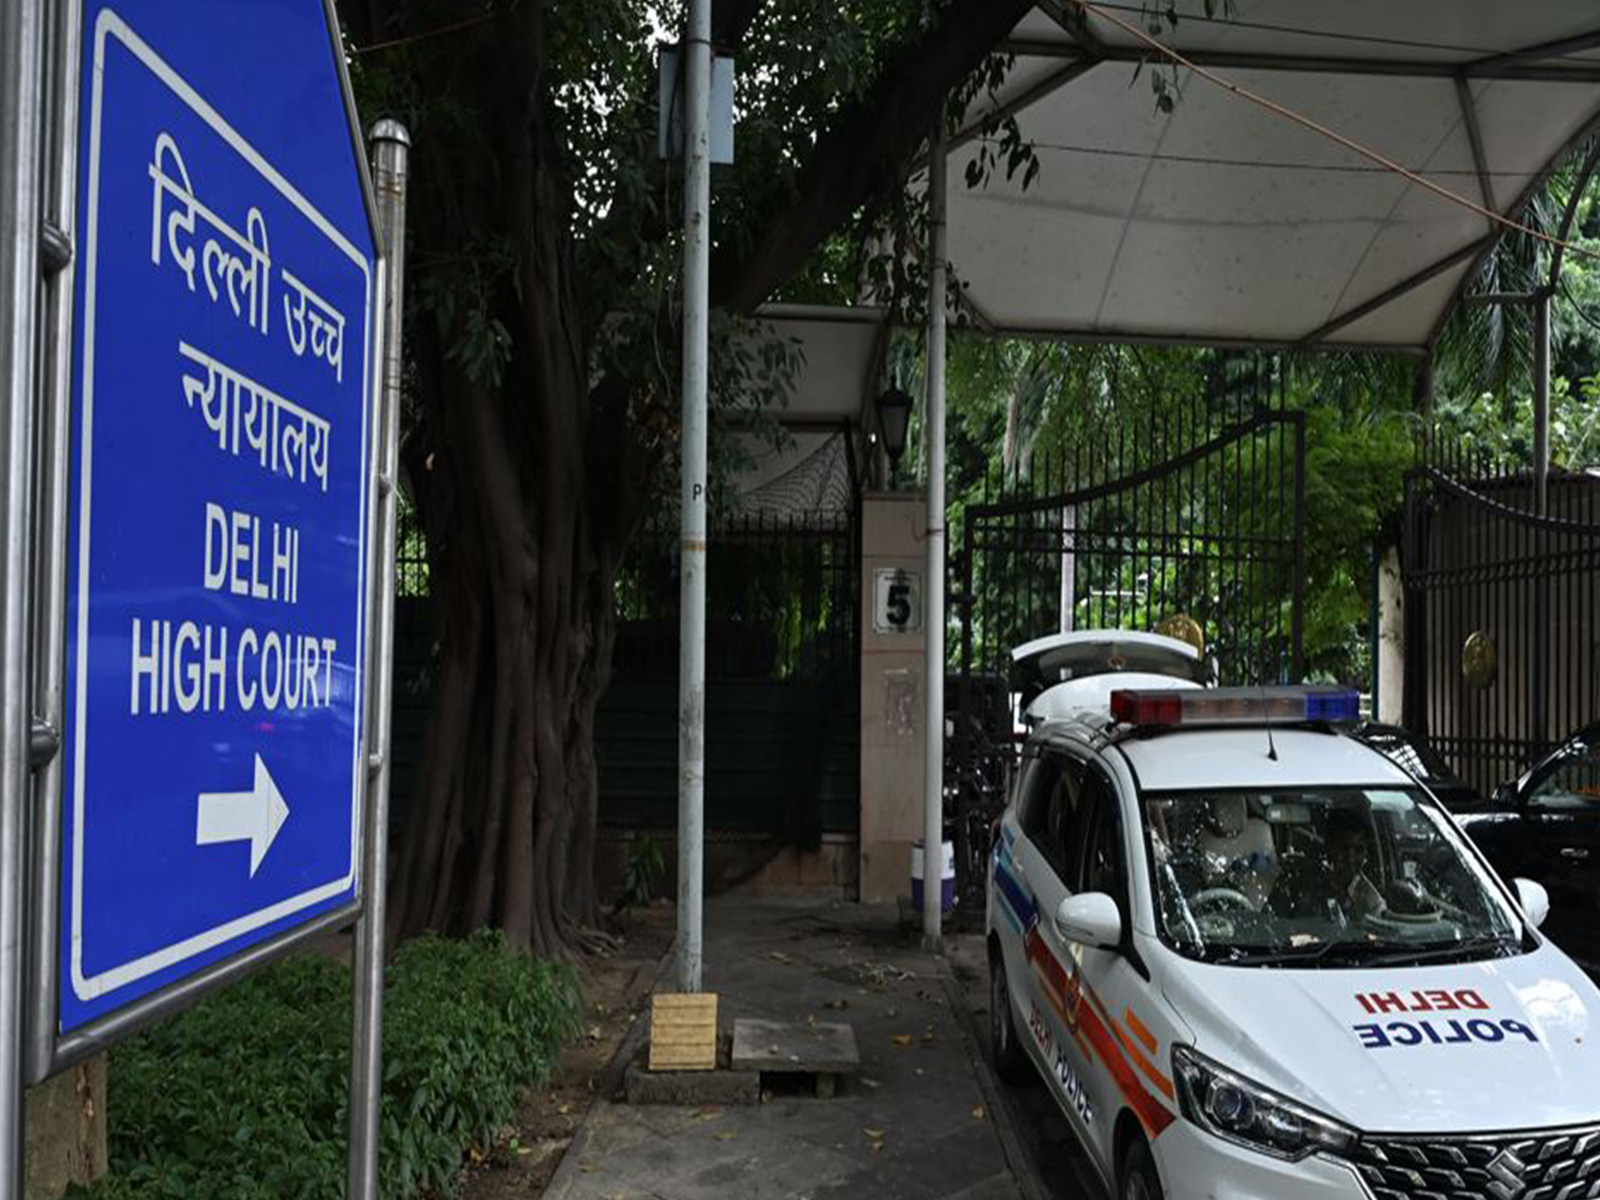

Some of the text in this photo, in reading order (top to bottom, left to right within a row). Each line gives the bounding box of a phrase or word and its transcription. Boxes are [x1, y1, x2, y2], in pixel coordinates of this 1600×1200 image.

[149, 132, 346, 383] दिल्ली उच्च
[179, 341, 331, 492] न्यायालय
[204, 502, 299, 604] DELHI
[886, 584, 911, 625] 5
[130, 618, 337, 715] HIGH COURT
[1055, 1045, 1094, 1125] POLICE
